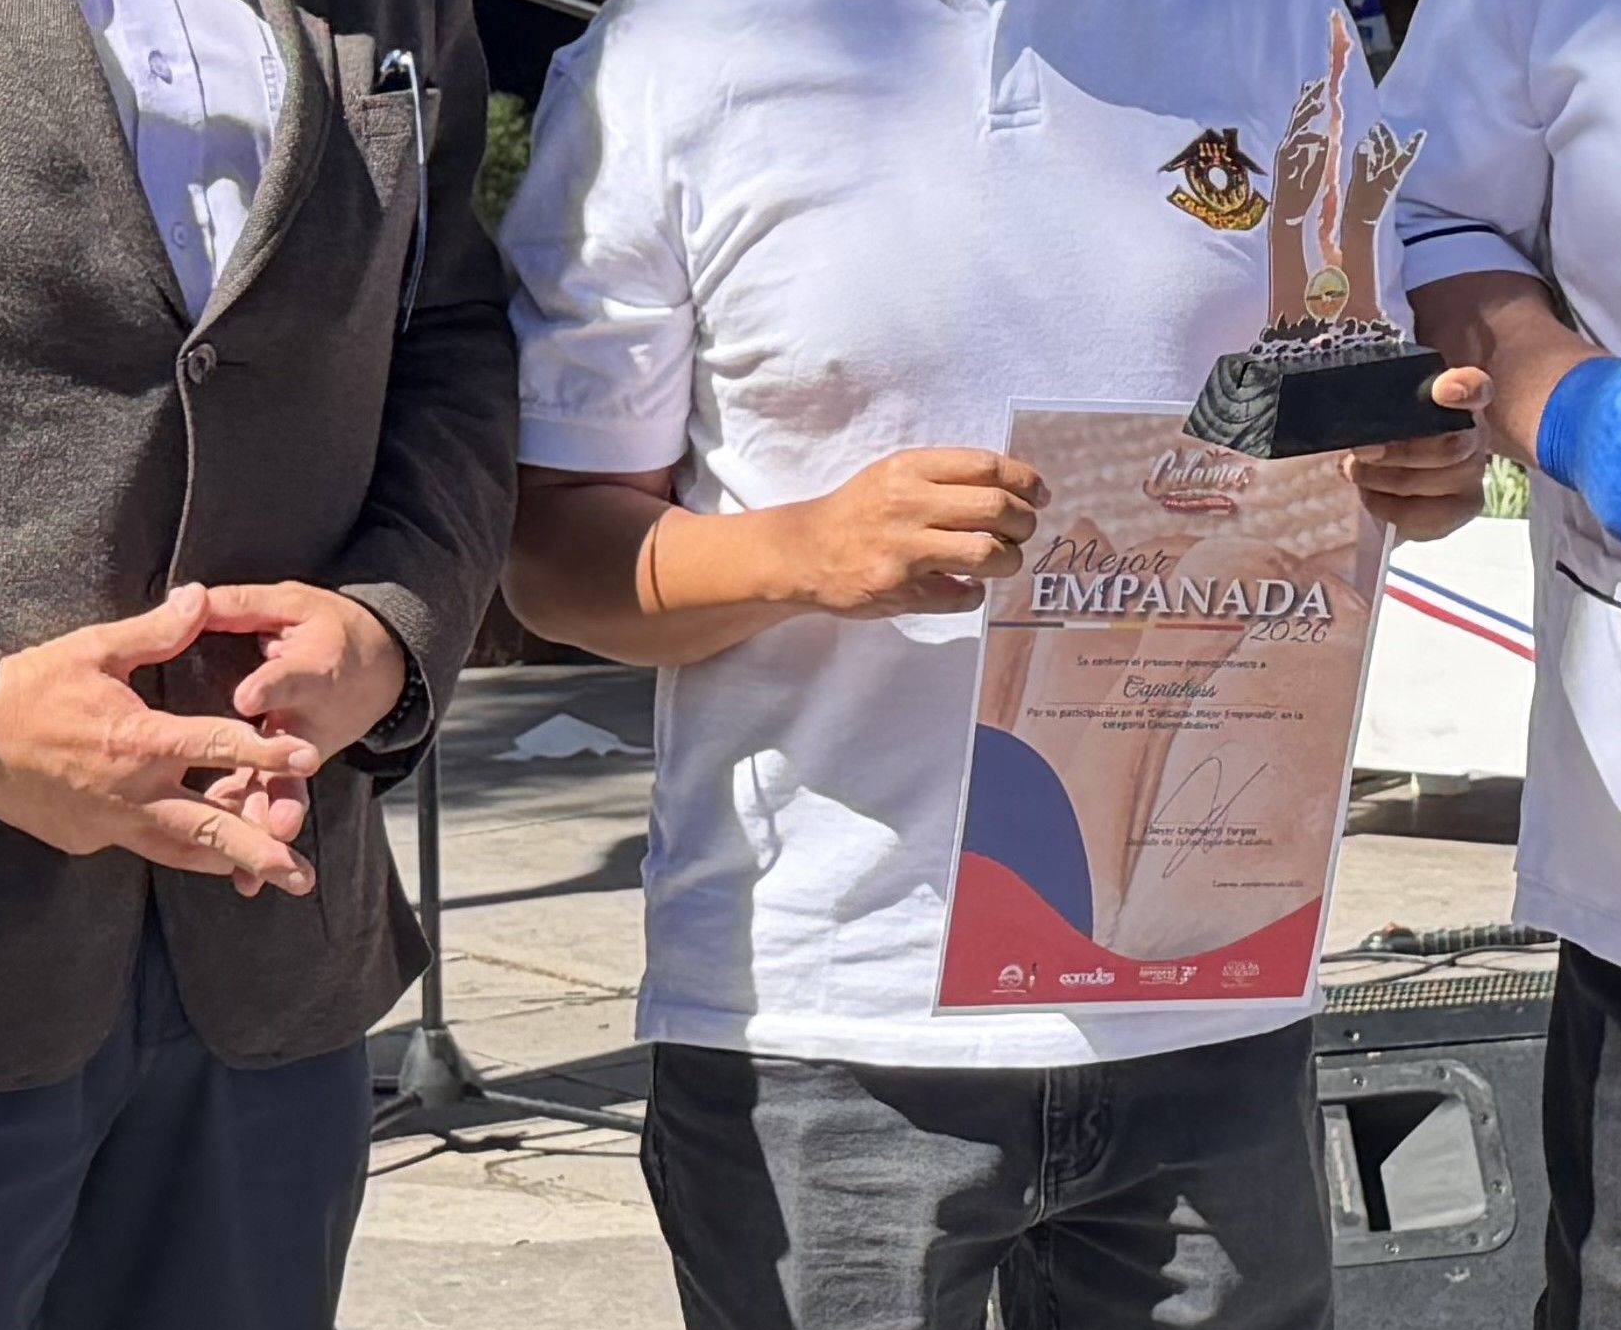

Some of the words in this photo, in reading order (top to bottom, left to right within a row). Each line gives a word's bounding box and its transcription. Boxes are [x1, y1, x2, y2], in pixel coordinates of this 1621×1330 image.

[1032, 535, 1179, 577] Mejor
[1030, 572, 1333, 621] EMPANADA
[1249, 619, 1329, 643] 2026
